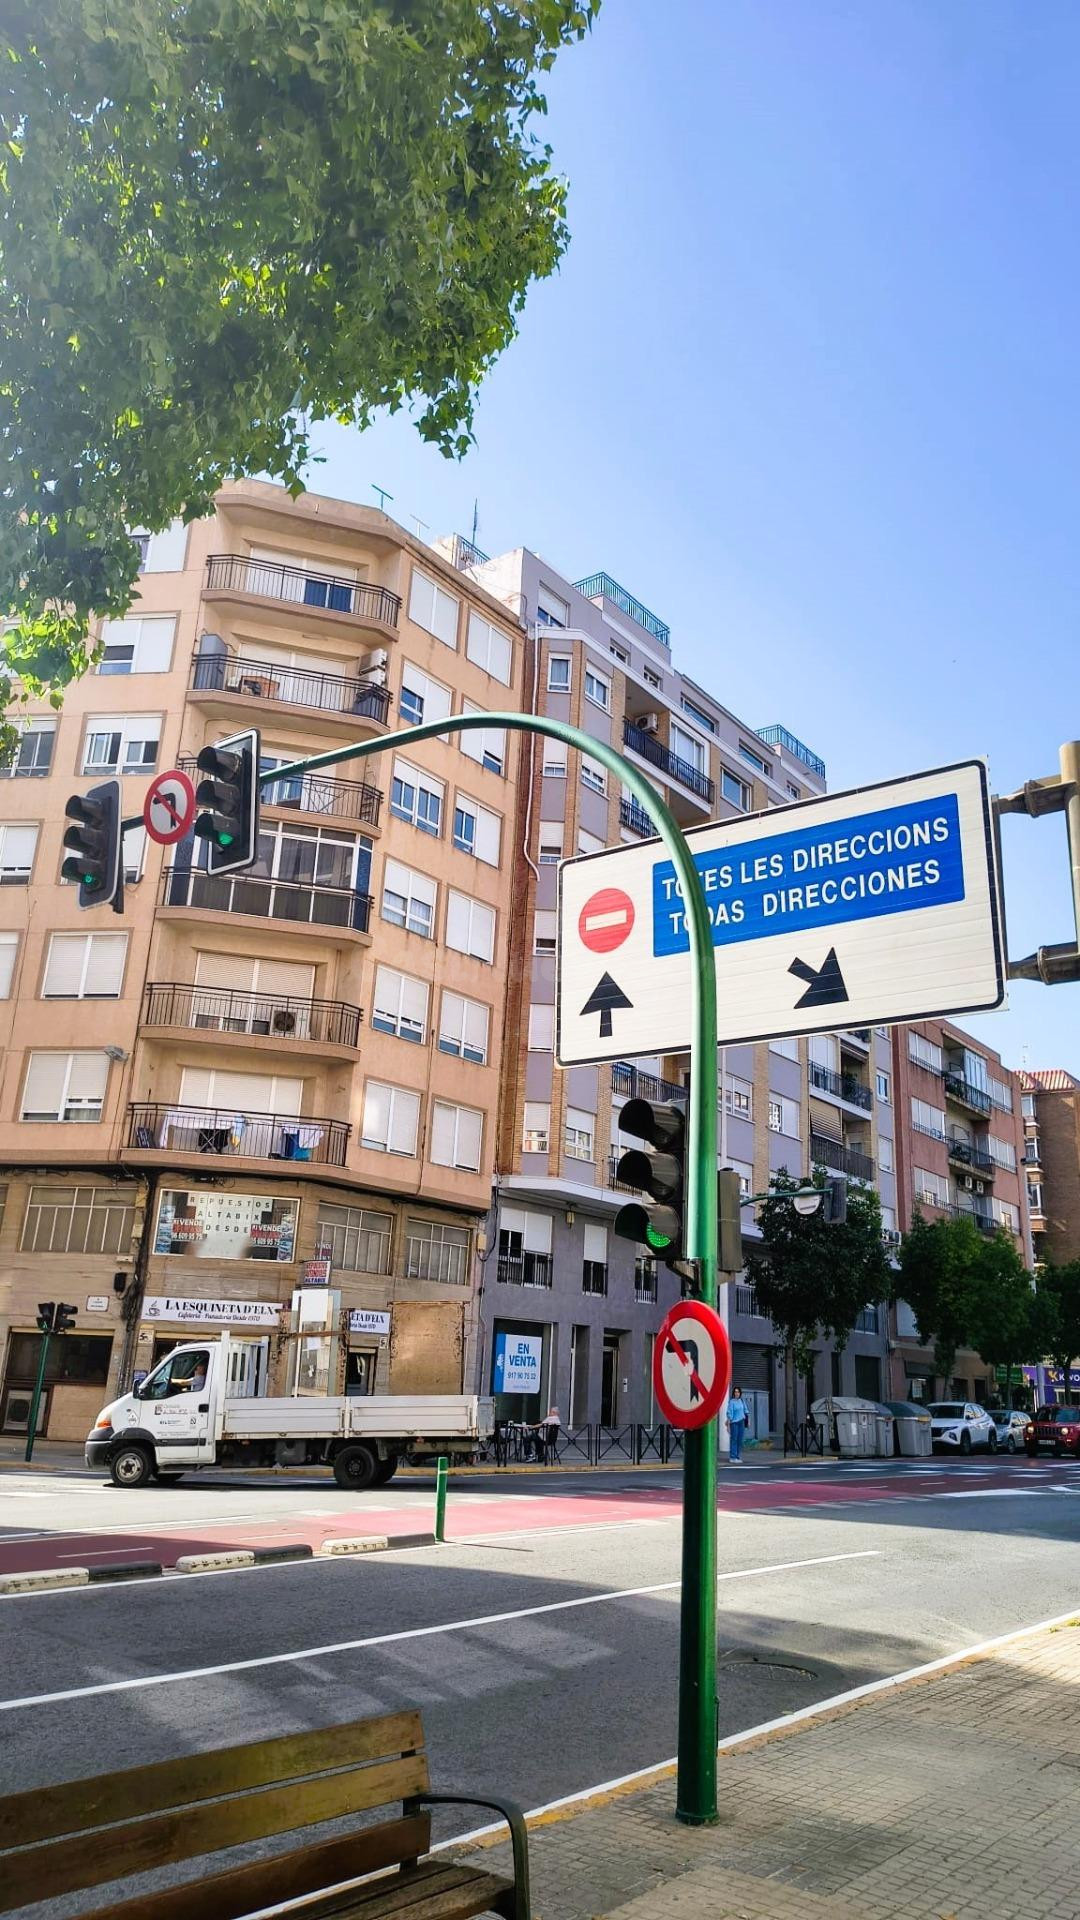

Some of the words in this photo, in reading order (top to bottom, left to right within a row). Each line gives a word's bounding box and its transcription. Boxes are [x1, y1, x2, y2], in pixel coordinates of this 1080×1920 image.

[662, 865, 733, 900] TES
[741, 854, 784, 884] LES
[793, 817, 949, 873] DIRECCIONS
[763, 859, 940, 917] DIRECCIONES
[190, 1196, 270, 1208] REPUESTOS
[205, 1225, 248, 1233] DESDE
[165, 1300, 179, 1310] LA
[182, 1302, 241, 1313] ESQUINETA
[243, 1305, 275, 1316] D'ELX
[517, 1343, 530, 1354] EN
[509, 1355, 537, 1367] VENTA
